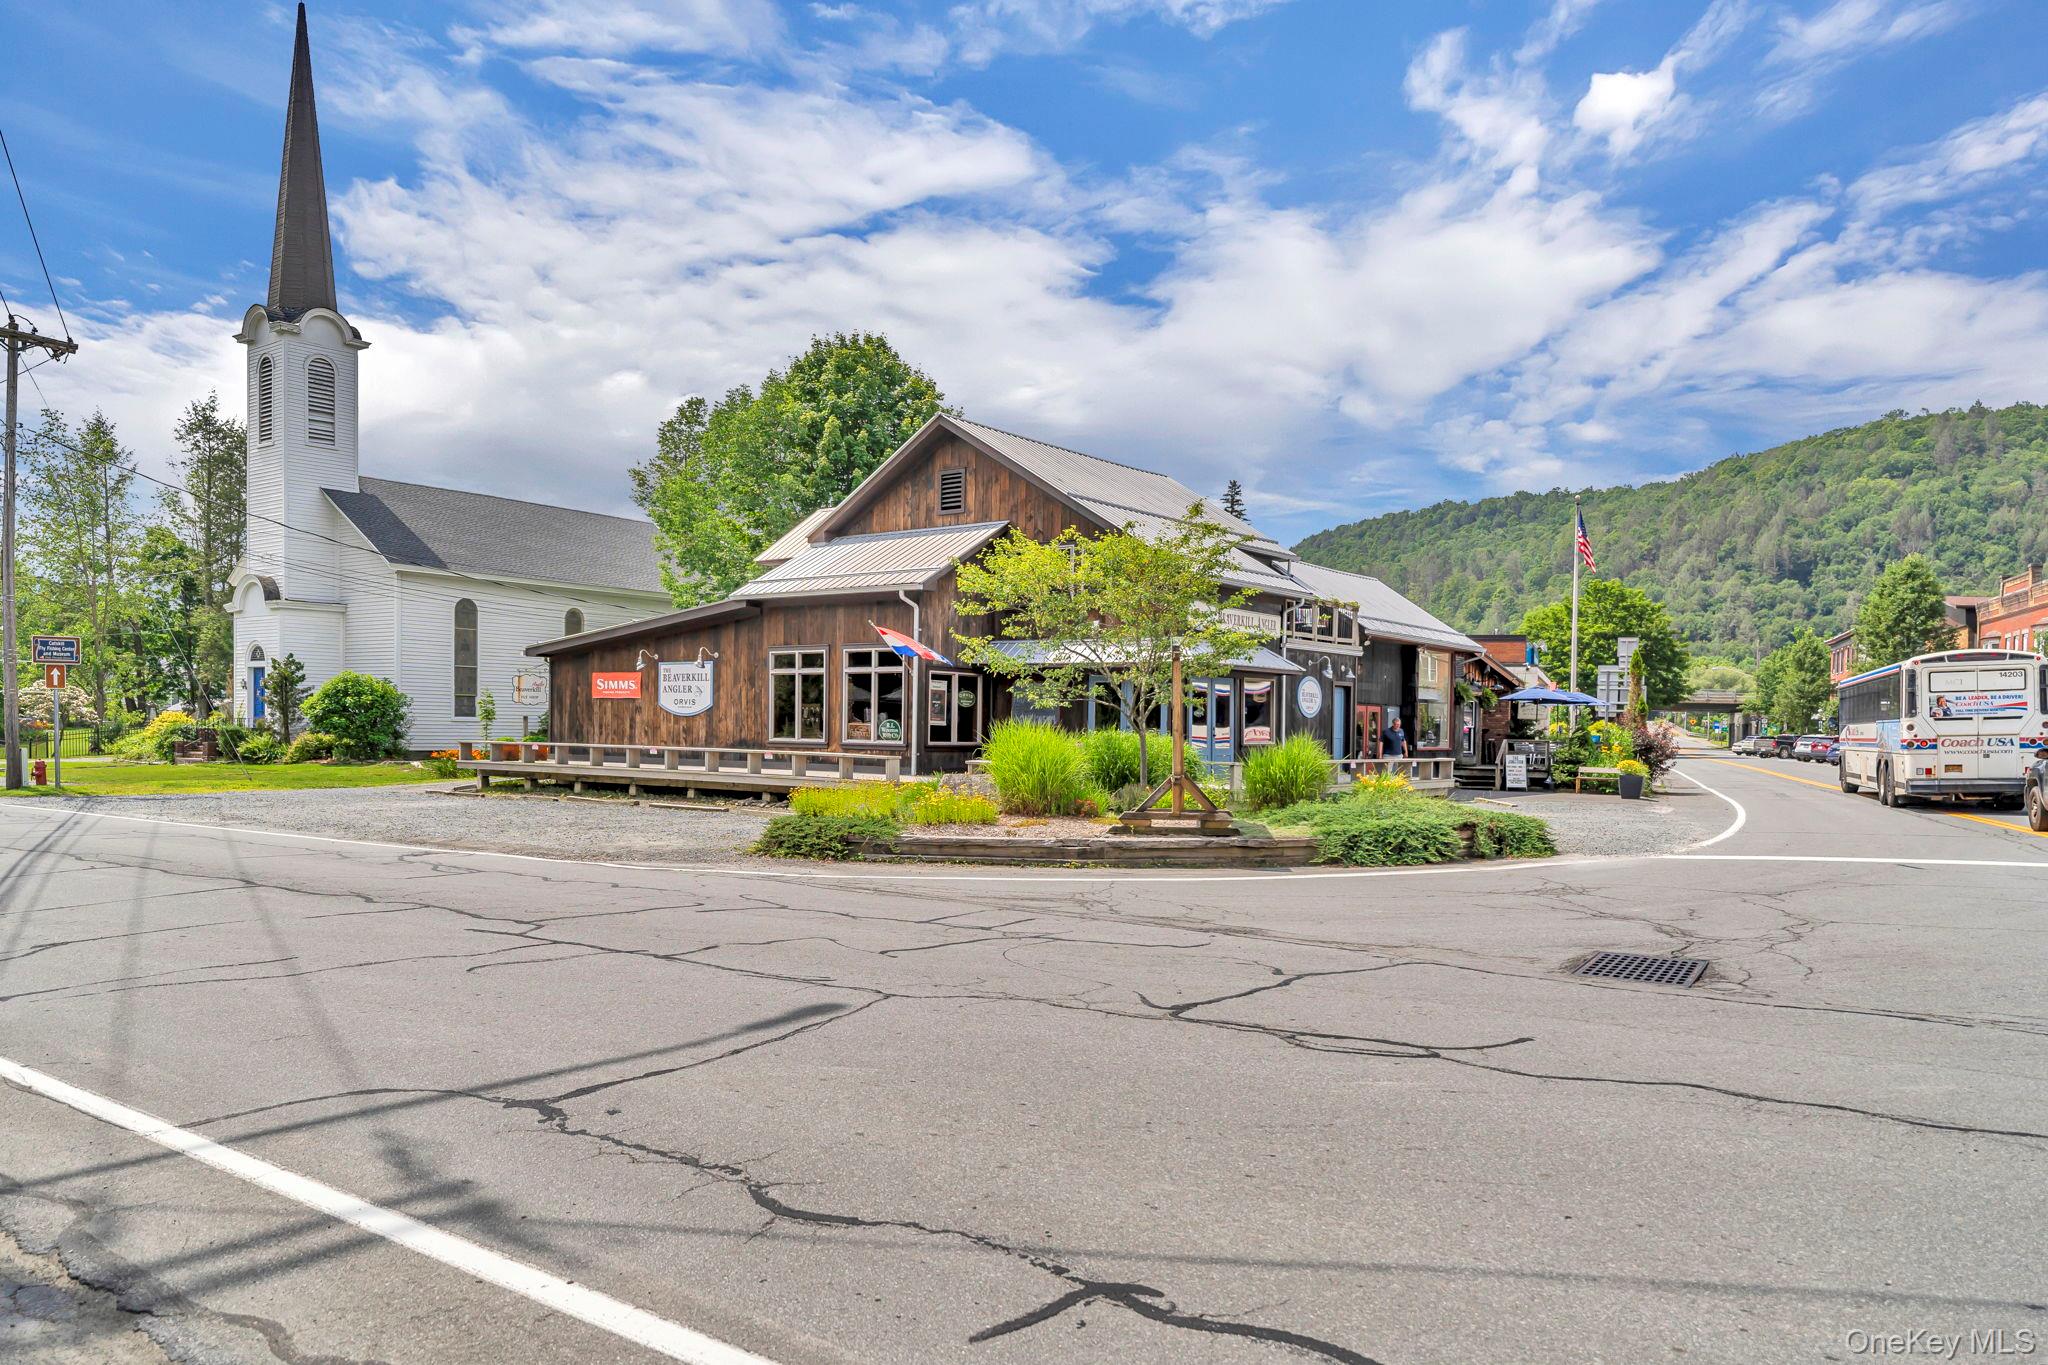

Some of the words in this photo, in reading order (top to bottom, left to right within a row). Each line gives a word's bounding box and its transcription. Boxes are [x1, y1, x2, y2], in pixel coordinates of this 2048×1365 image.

[662, 673, 710, 682] BEAVERKILL
[596, 678, 636, 690] SIMMS
[662, 685, 693, 694] ANGLER
[673, 698, 696, 706] ORVIS
[1941, 737, 1984, 747] Coach
[1987, 737, 2015, 747] USA
